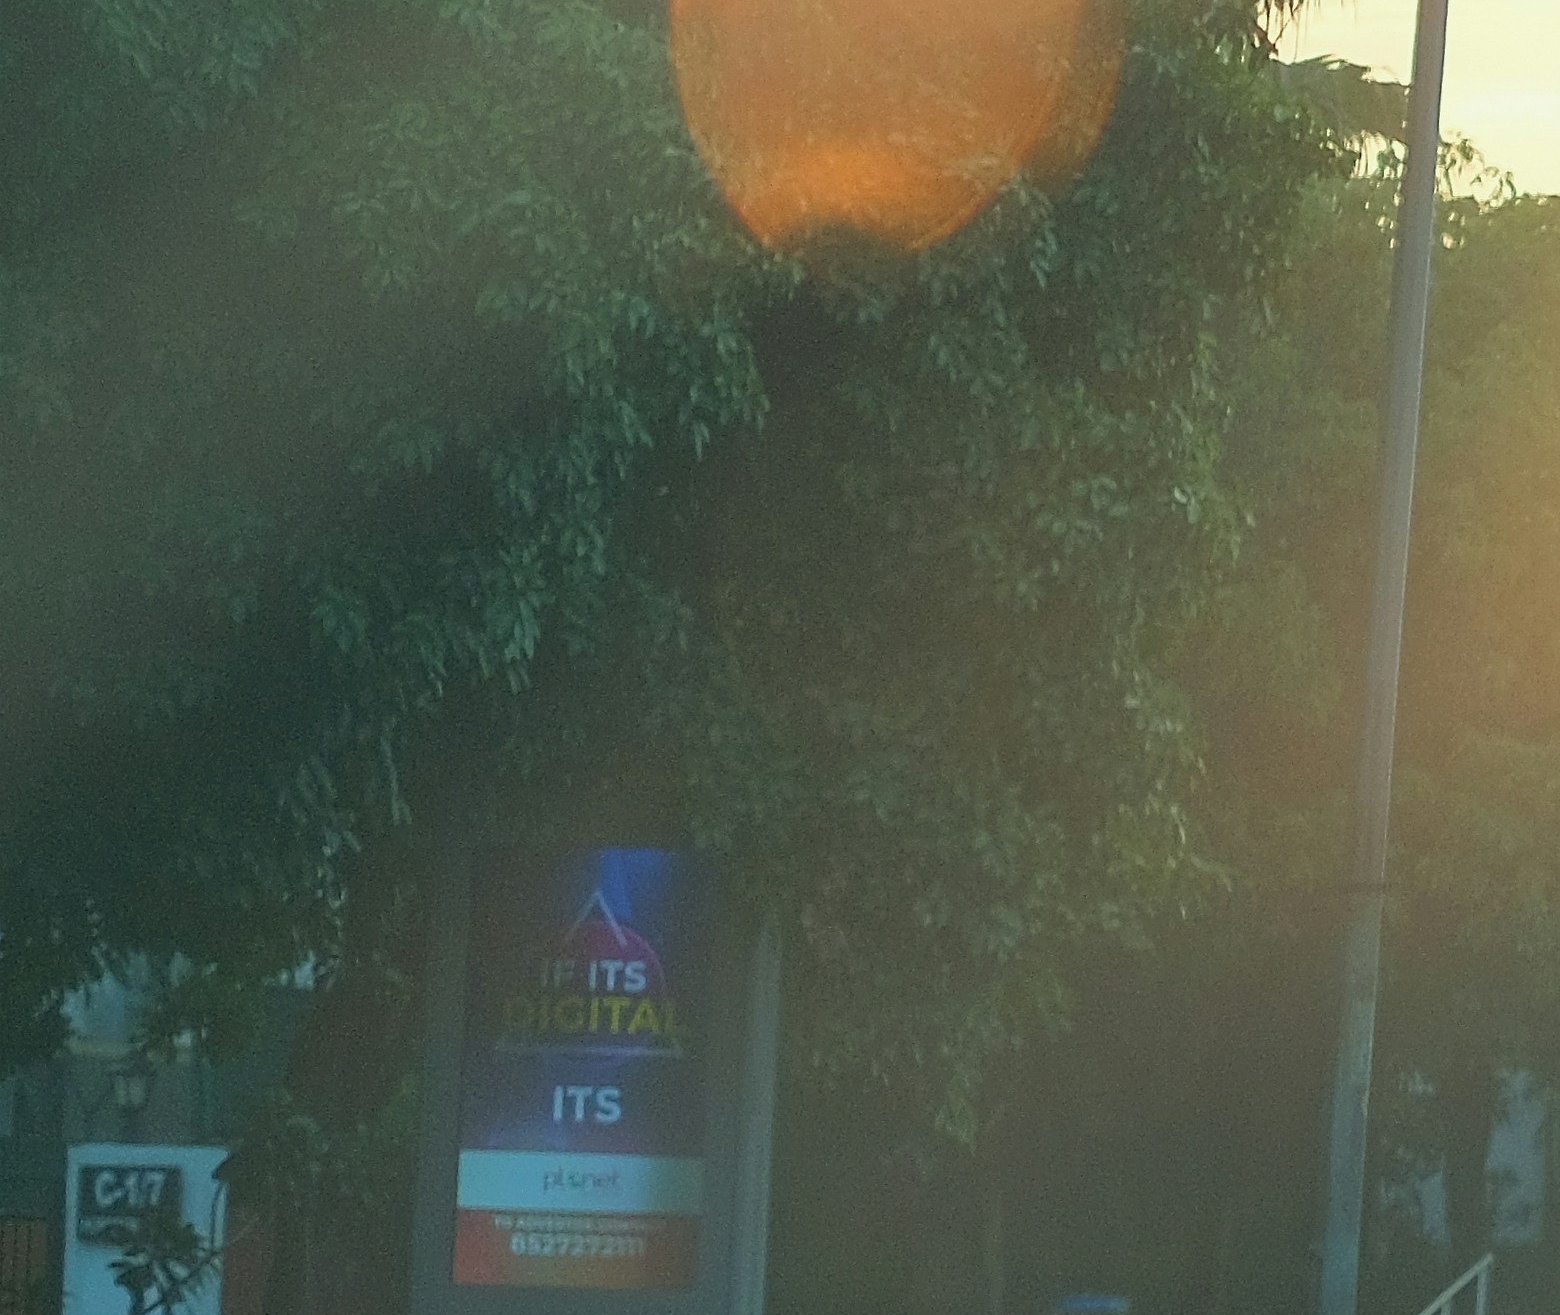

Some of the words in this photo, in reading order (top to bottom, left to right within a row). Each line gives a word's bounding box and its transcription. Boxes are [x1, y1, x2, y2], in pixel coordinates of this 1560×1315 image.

[588, 959, 647, 992] ITS
[502, 996, 682, 1036] DIGITAL
[552, 1085, 622, 1125] ITS
